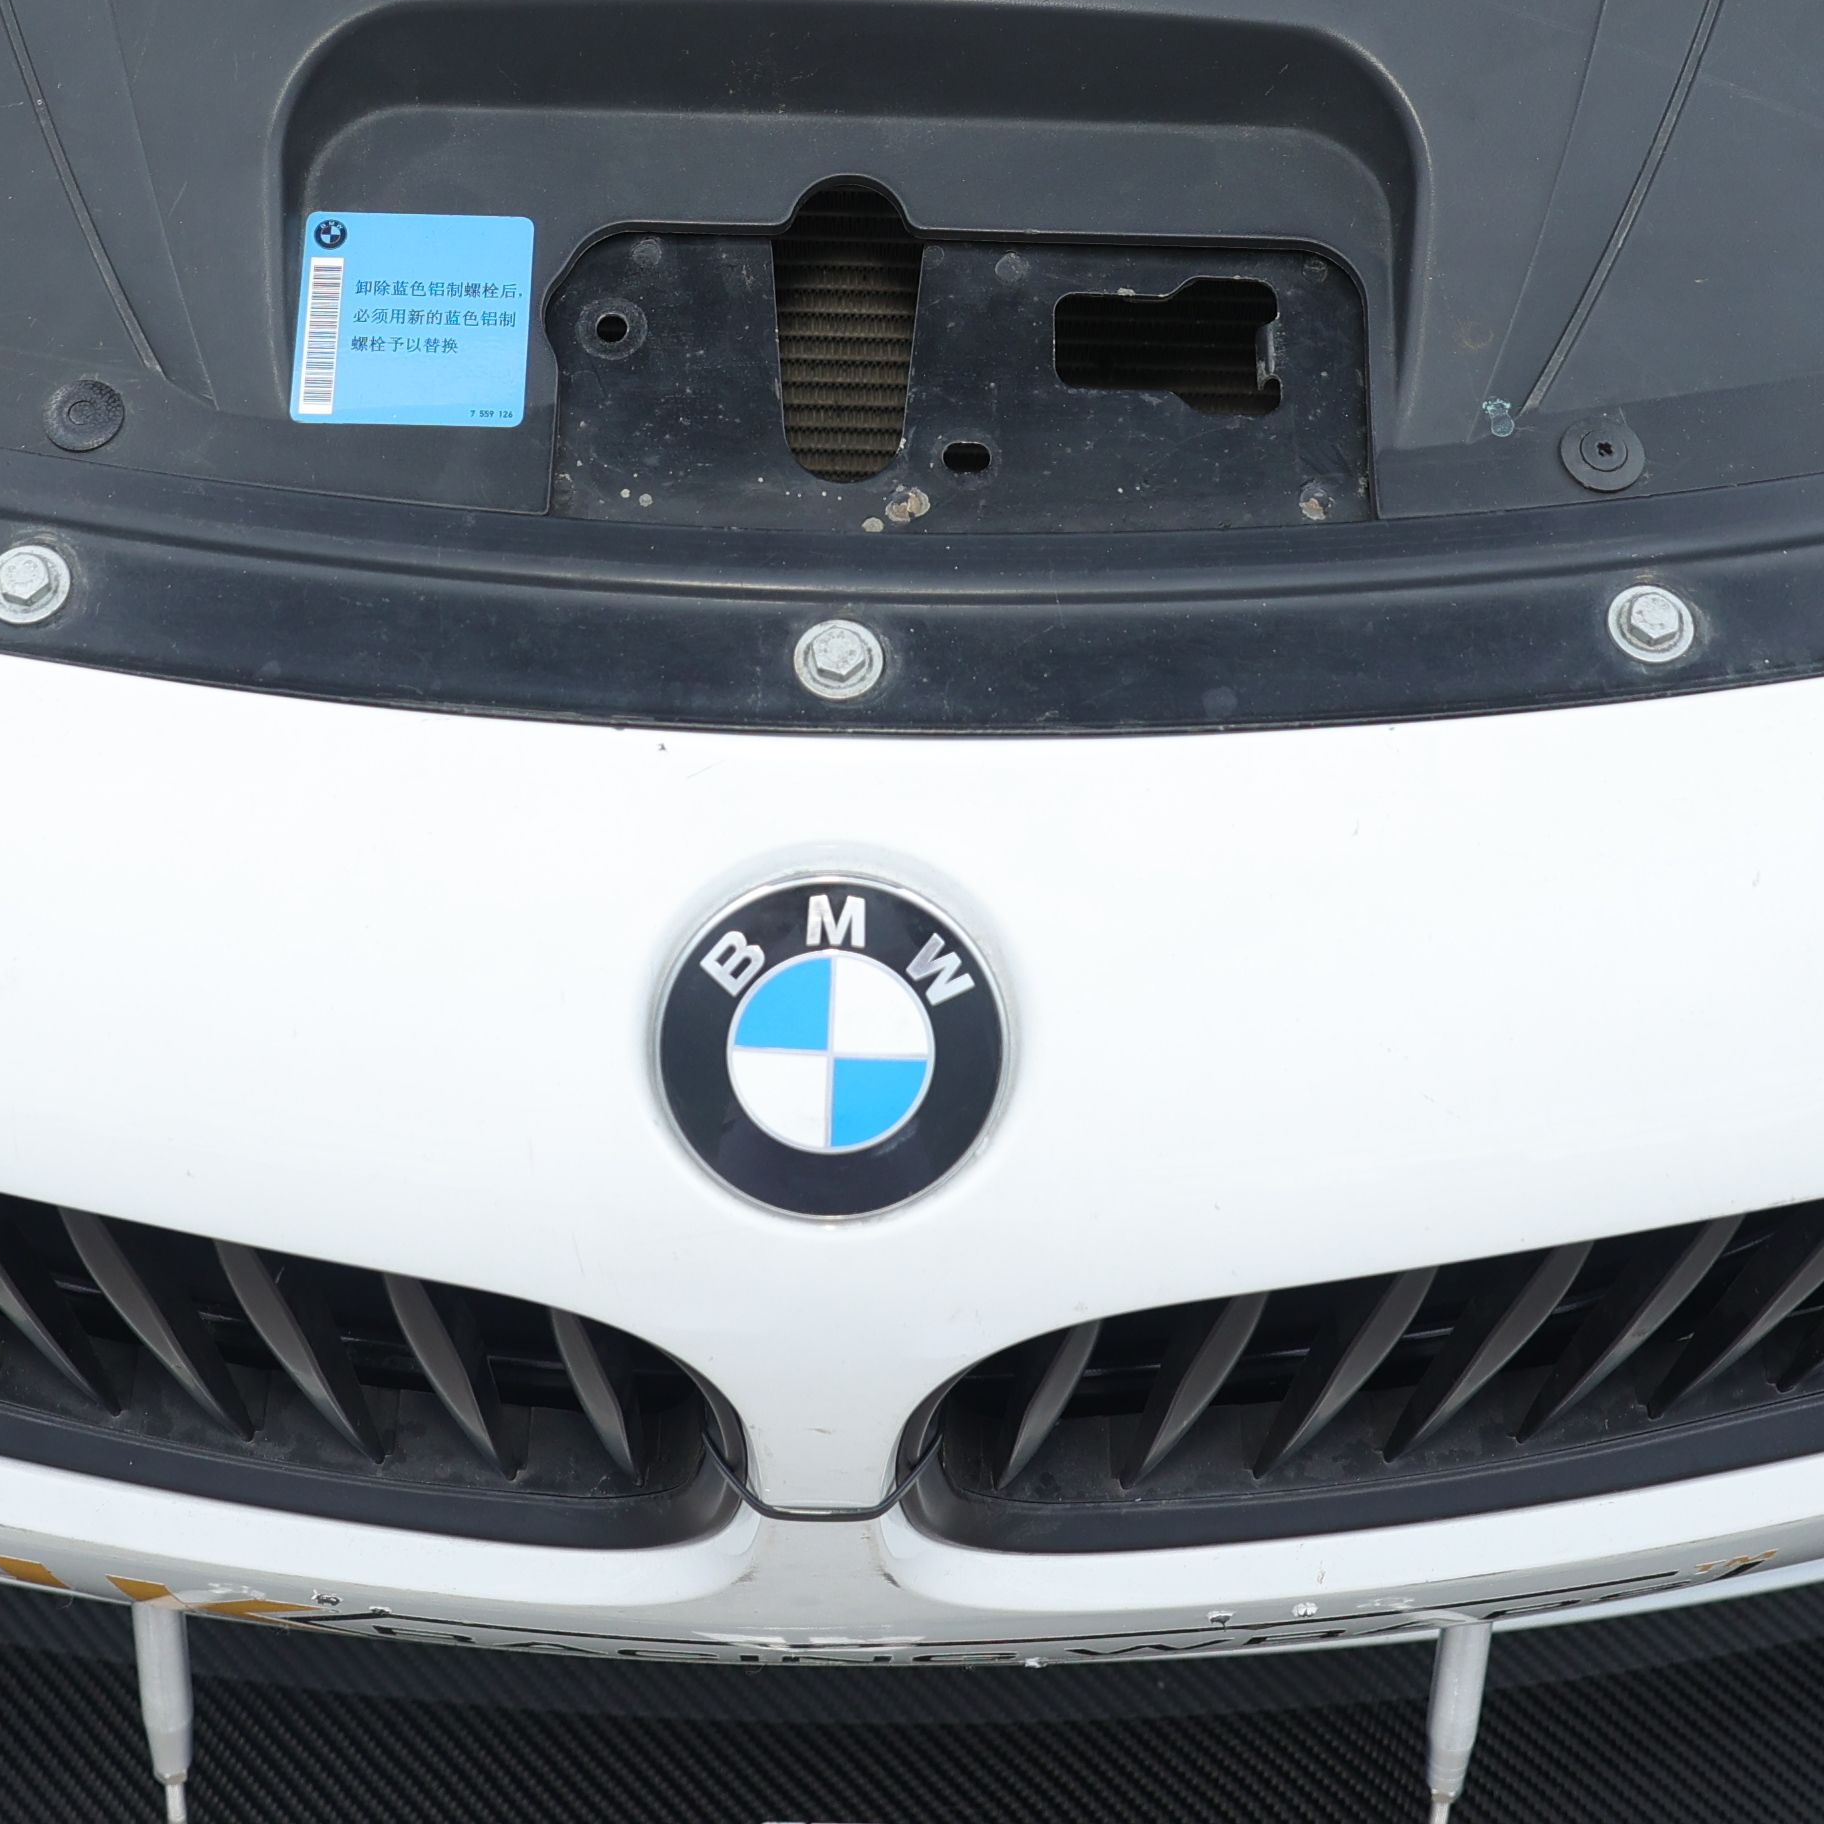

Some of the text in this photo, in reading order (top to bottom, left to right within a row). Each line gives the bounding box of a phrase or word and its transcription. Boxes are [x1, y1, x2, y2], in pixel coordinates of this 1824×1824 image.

[352, 308, 516, 328] 必须用新的蓝色铝制
[351, 336, 458, 354] 螺栓予以替换
[499, 410, 513, 419] 126
[699, 894, 975, 1006] BMW
